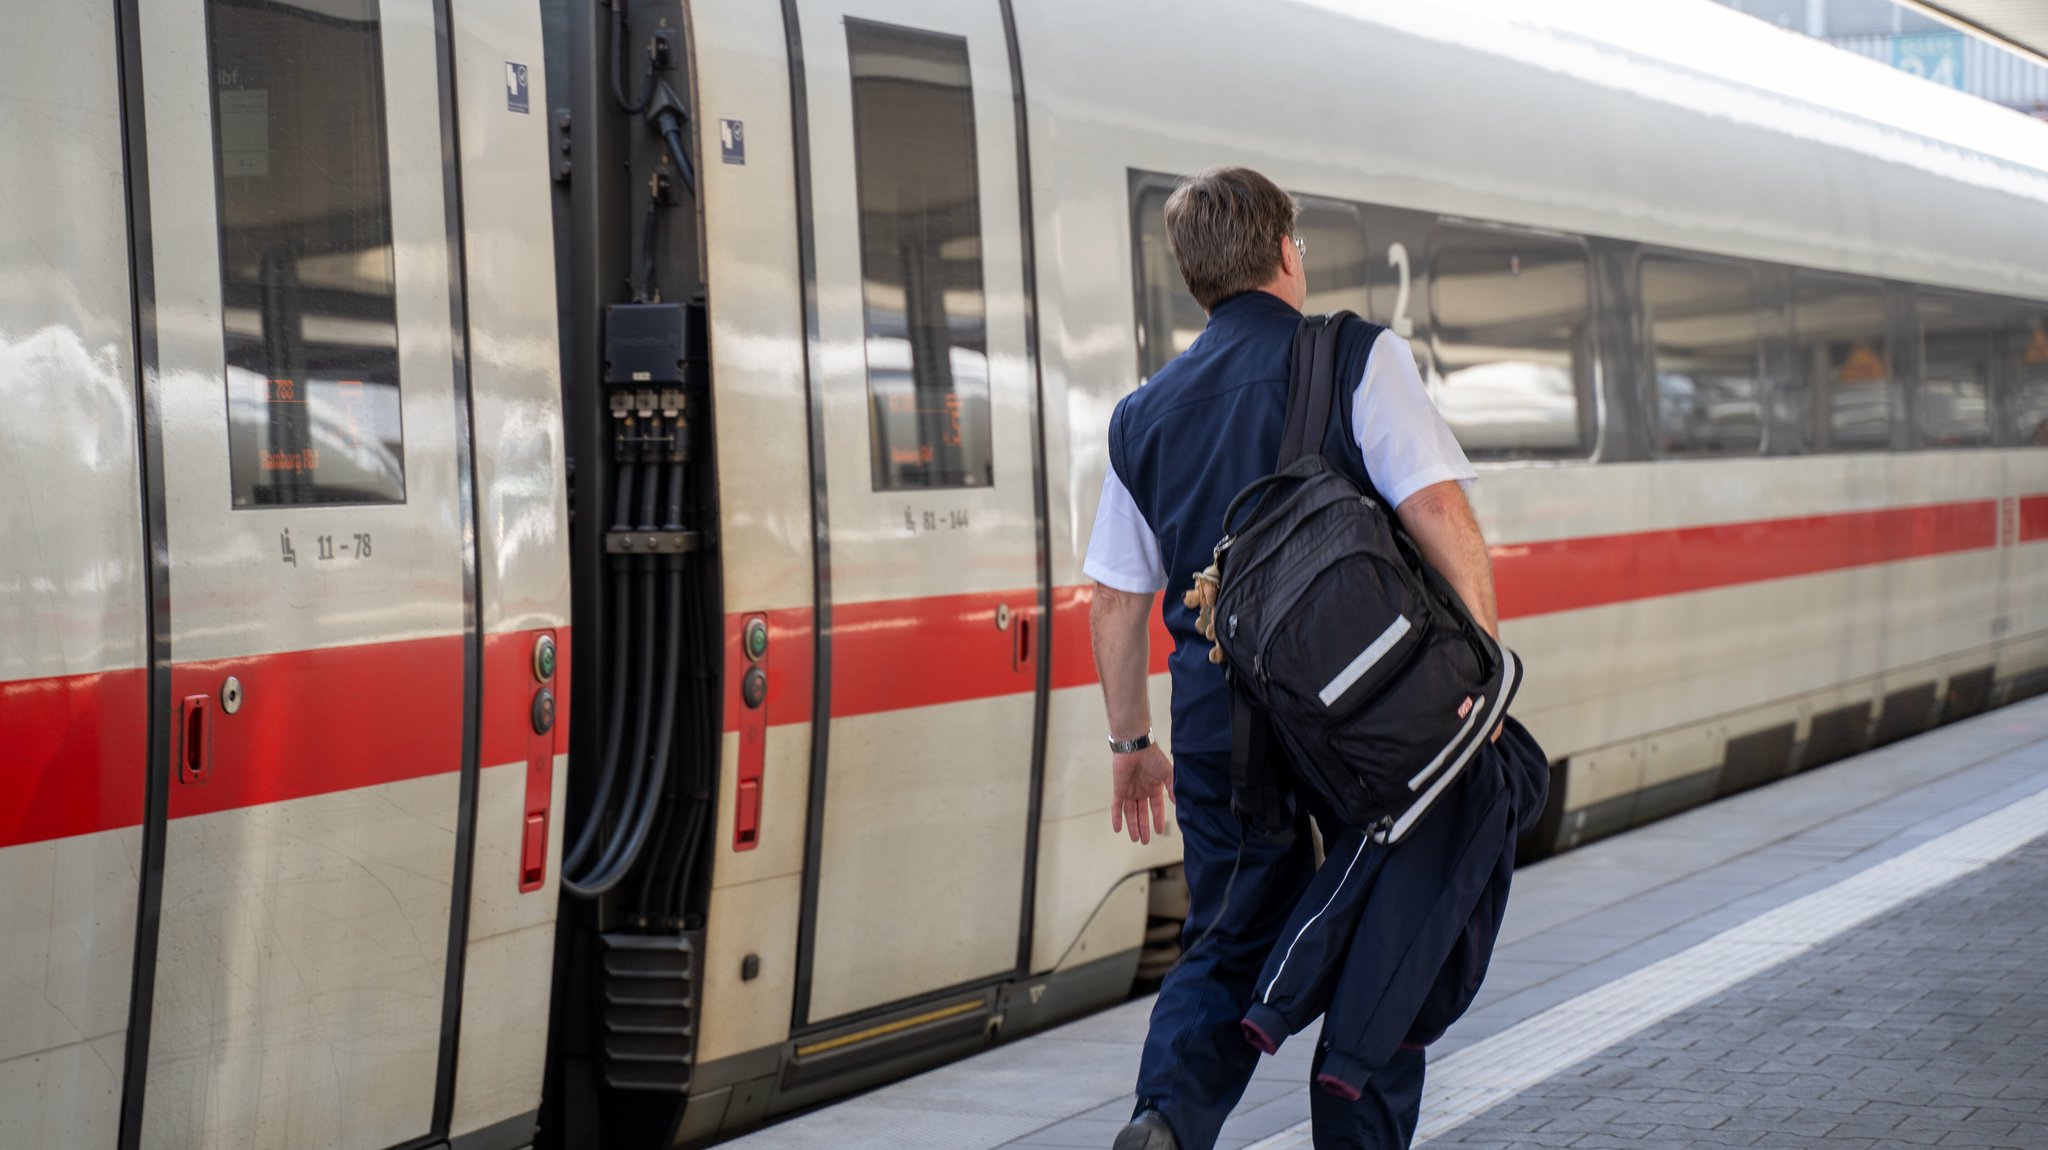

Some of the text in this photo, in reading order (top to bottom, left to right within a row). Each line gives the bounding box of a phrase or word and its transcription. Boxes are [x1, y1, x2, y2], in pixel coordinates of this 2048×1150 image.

[1388, 242, 1413, 337] 2
[317, 534, 335, 561] 11
[353, 532, 372, 560] 78
